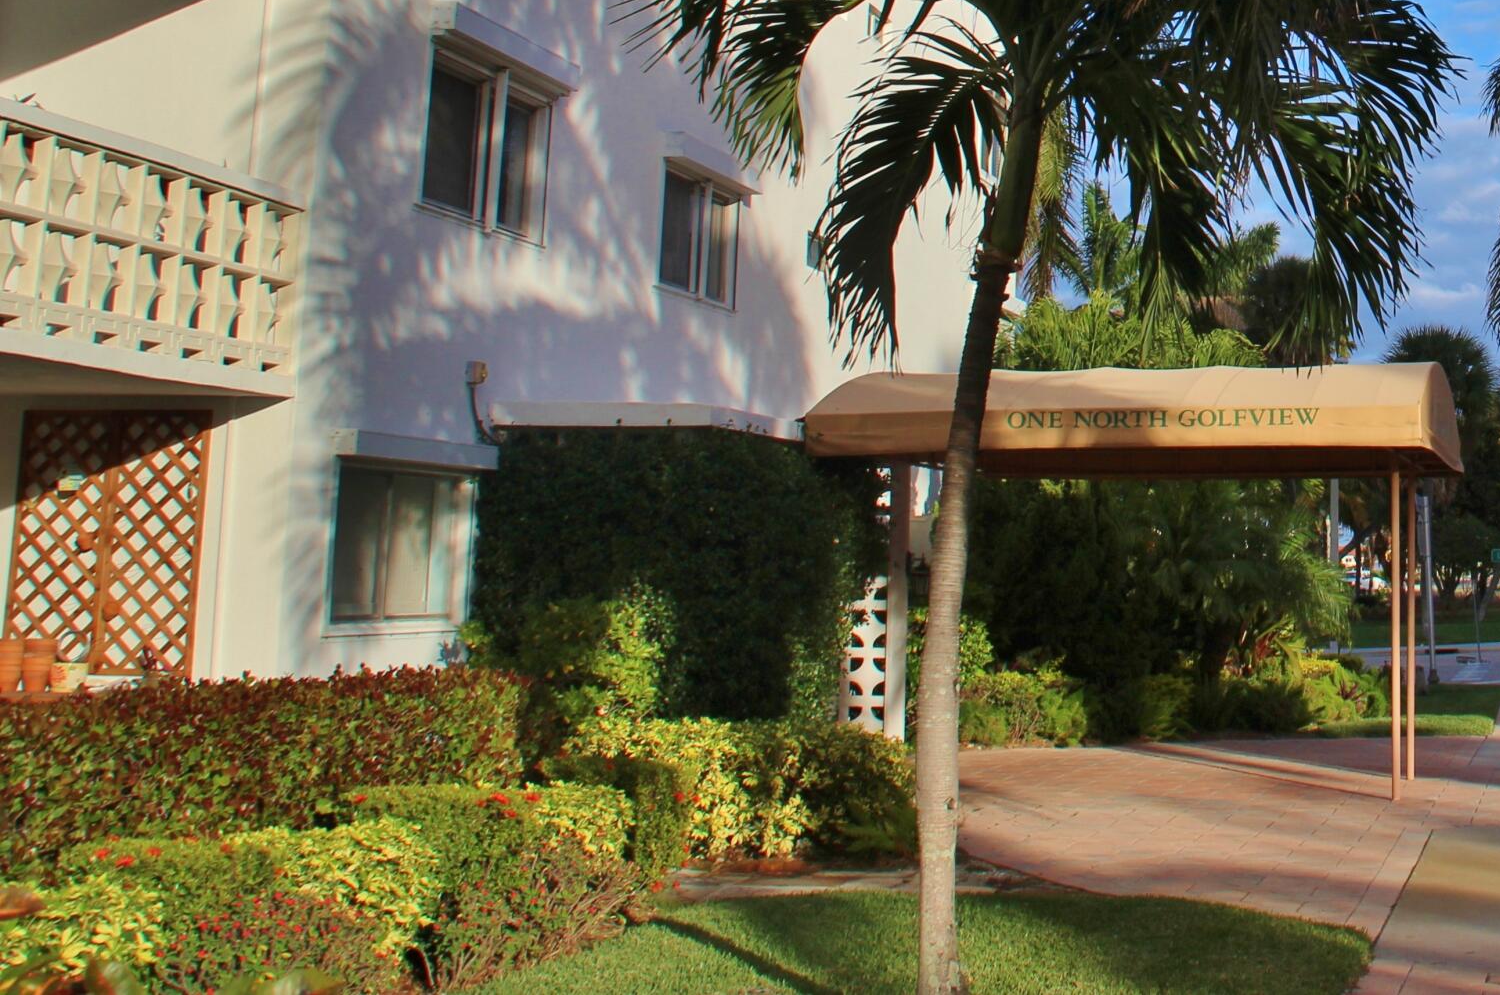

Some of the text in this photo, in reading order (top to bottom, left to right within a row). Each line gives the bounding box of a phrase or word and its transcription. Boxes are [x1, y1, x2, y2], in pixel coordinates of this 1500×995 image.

[1007, 407, 1320, 429] ONE NORTH GOLFVIEW
